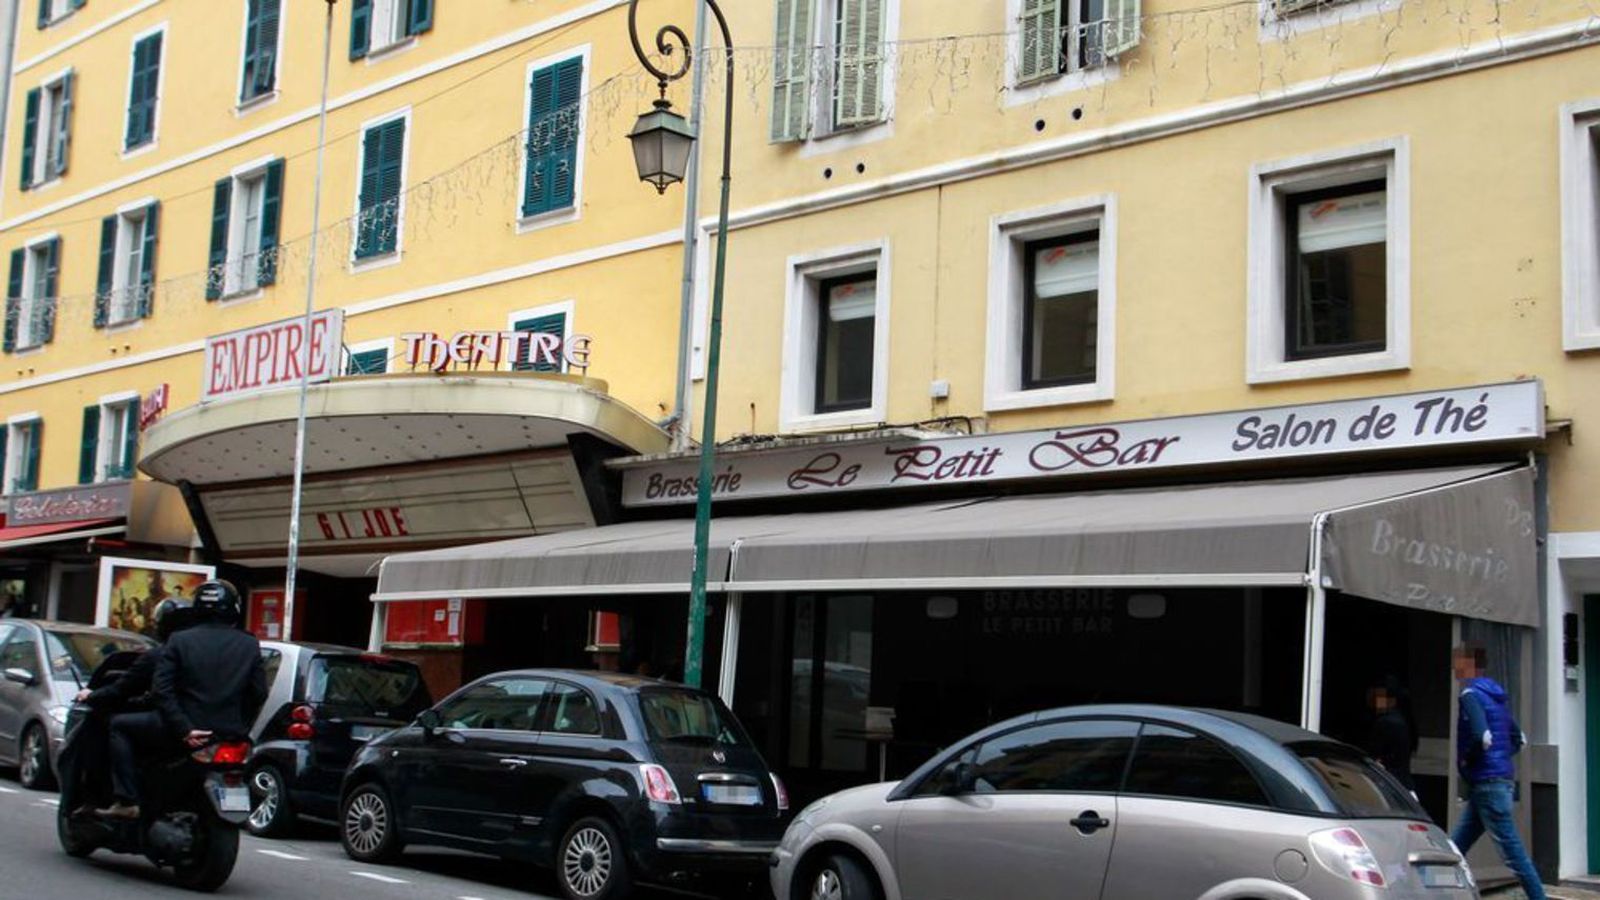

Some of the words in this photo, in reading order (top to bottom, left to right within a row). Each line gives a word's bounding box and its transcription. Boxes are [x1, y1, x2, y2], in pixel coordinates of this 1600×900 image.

[208, 319, 328, 396] EMPIRE
[646, 465, 742, 499] Brassrie
[788, 452, 862, 489] Le
[885, 444, 1003, 483] Petit
[1028, 427, 1180, 471] Bar
[1232, 413, 1337, 451] Salon
[1348, 405, 1397, 441] de
[1413, 392, 1490, 436] Thé
[1371, 519, 1508, 582] Brasserie
[1011, 617, 1064, 634] PETIT
[1072, 616, 1113, 634] BAR
